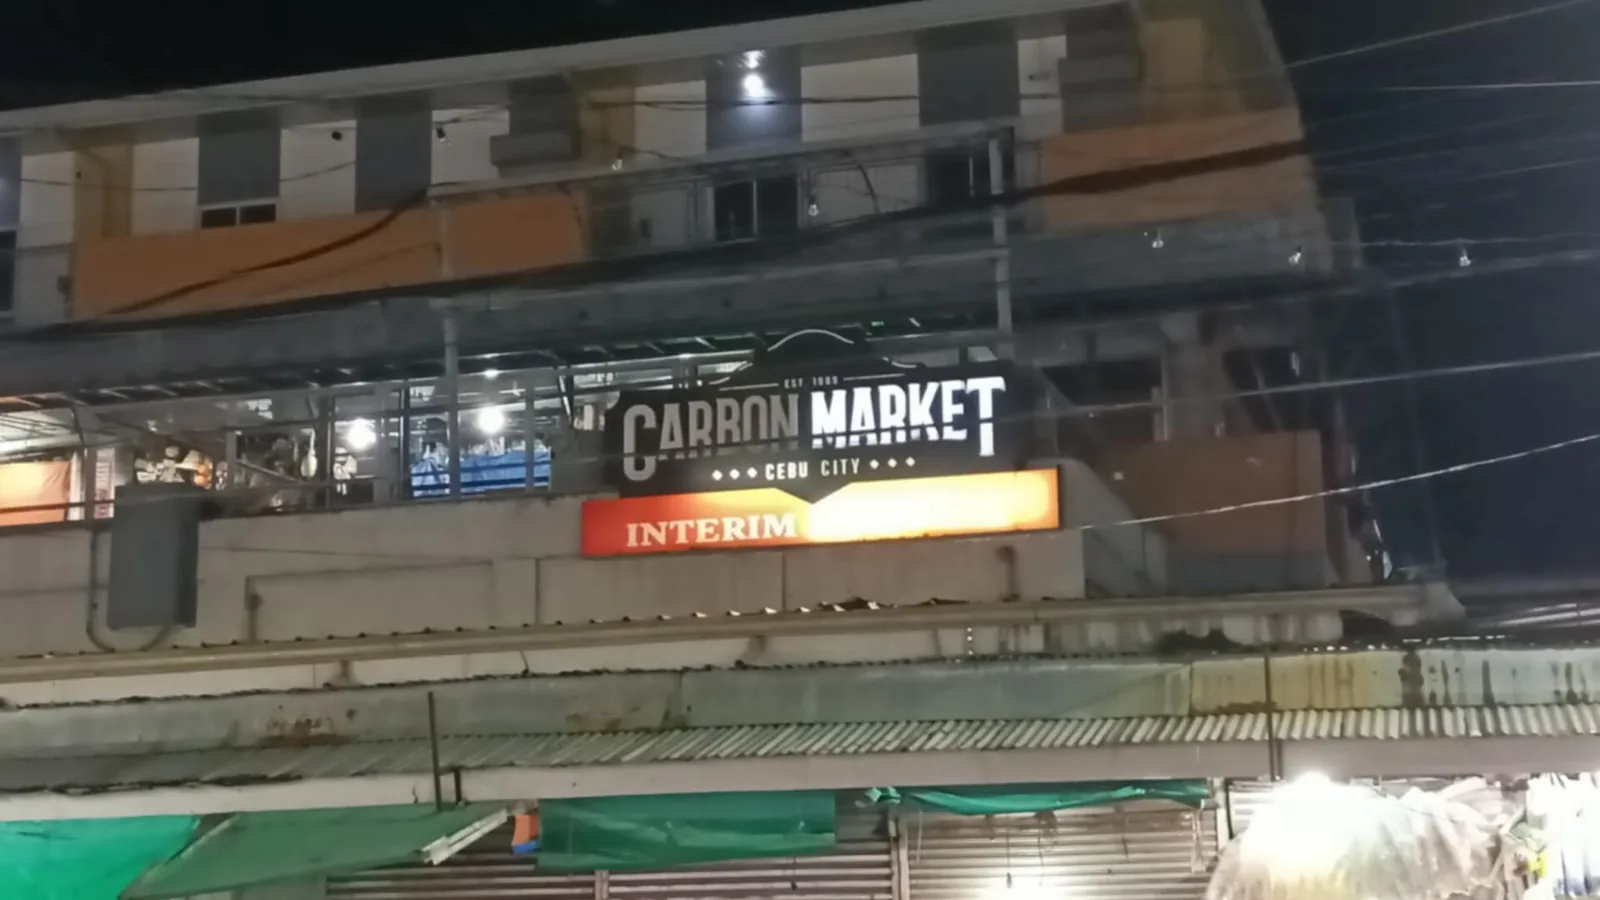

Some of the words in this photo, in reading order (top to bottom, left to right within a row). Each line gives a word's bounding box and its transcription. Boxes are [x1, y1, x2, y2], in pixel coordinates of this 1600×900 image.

[623, 393, 799, 481] CARBON
[811, 376, 1006, 457] MARKET
[765, 462, 808, 480] CEBU
[820, 458, 860, 477] CITY
[626, 513, 797, 548] INTERIM
